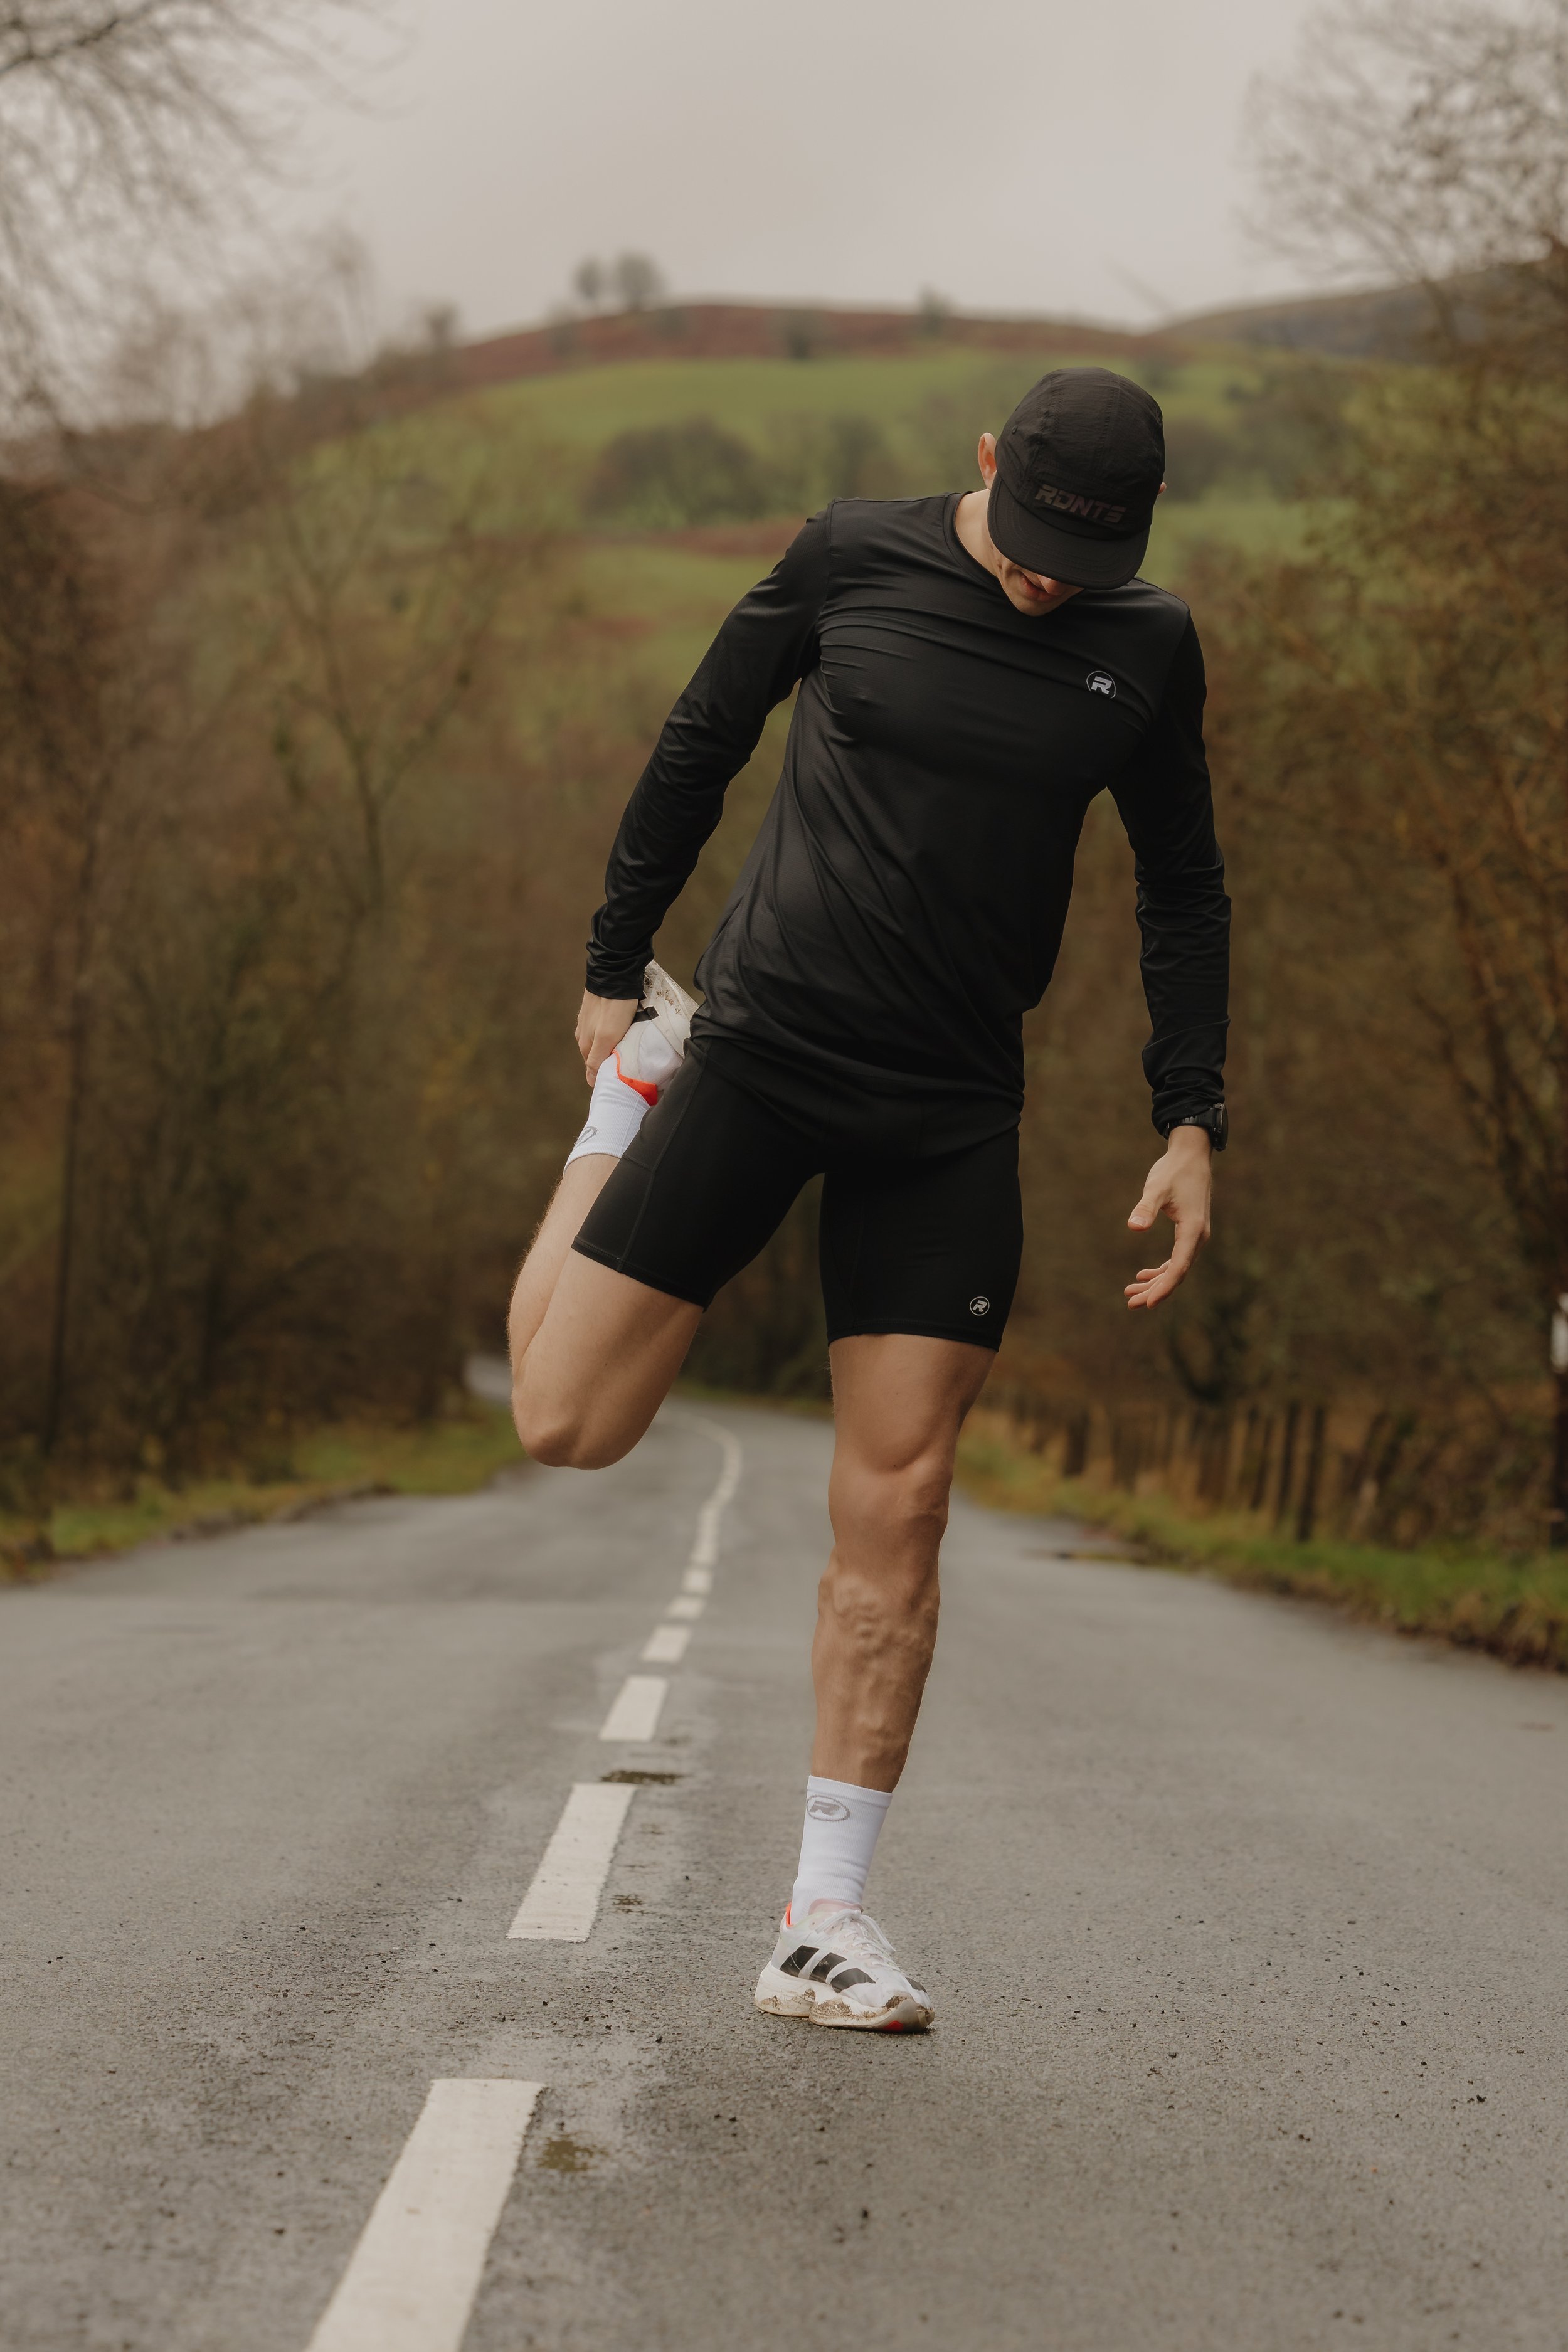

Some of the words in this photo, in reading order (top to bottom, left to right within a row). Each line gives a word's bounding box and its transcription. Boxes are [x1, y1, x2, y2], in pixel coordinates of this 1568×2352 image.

[1035, 484, 1127, 523] RDNTS
[1091, 676, 1112, 694] R
[972, 1300, 988, 1312] R
